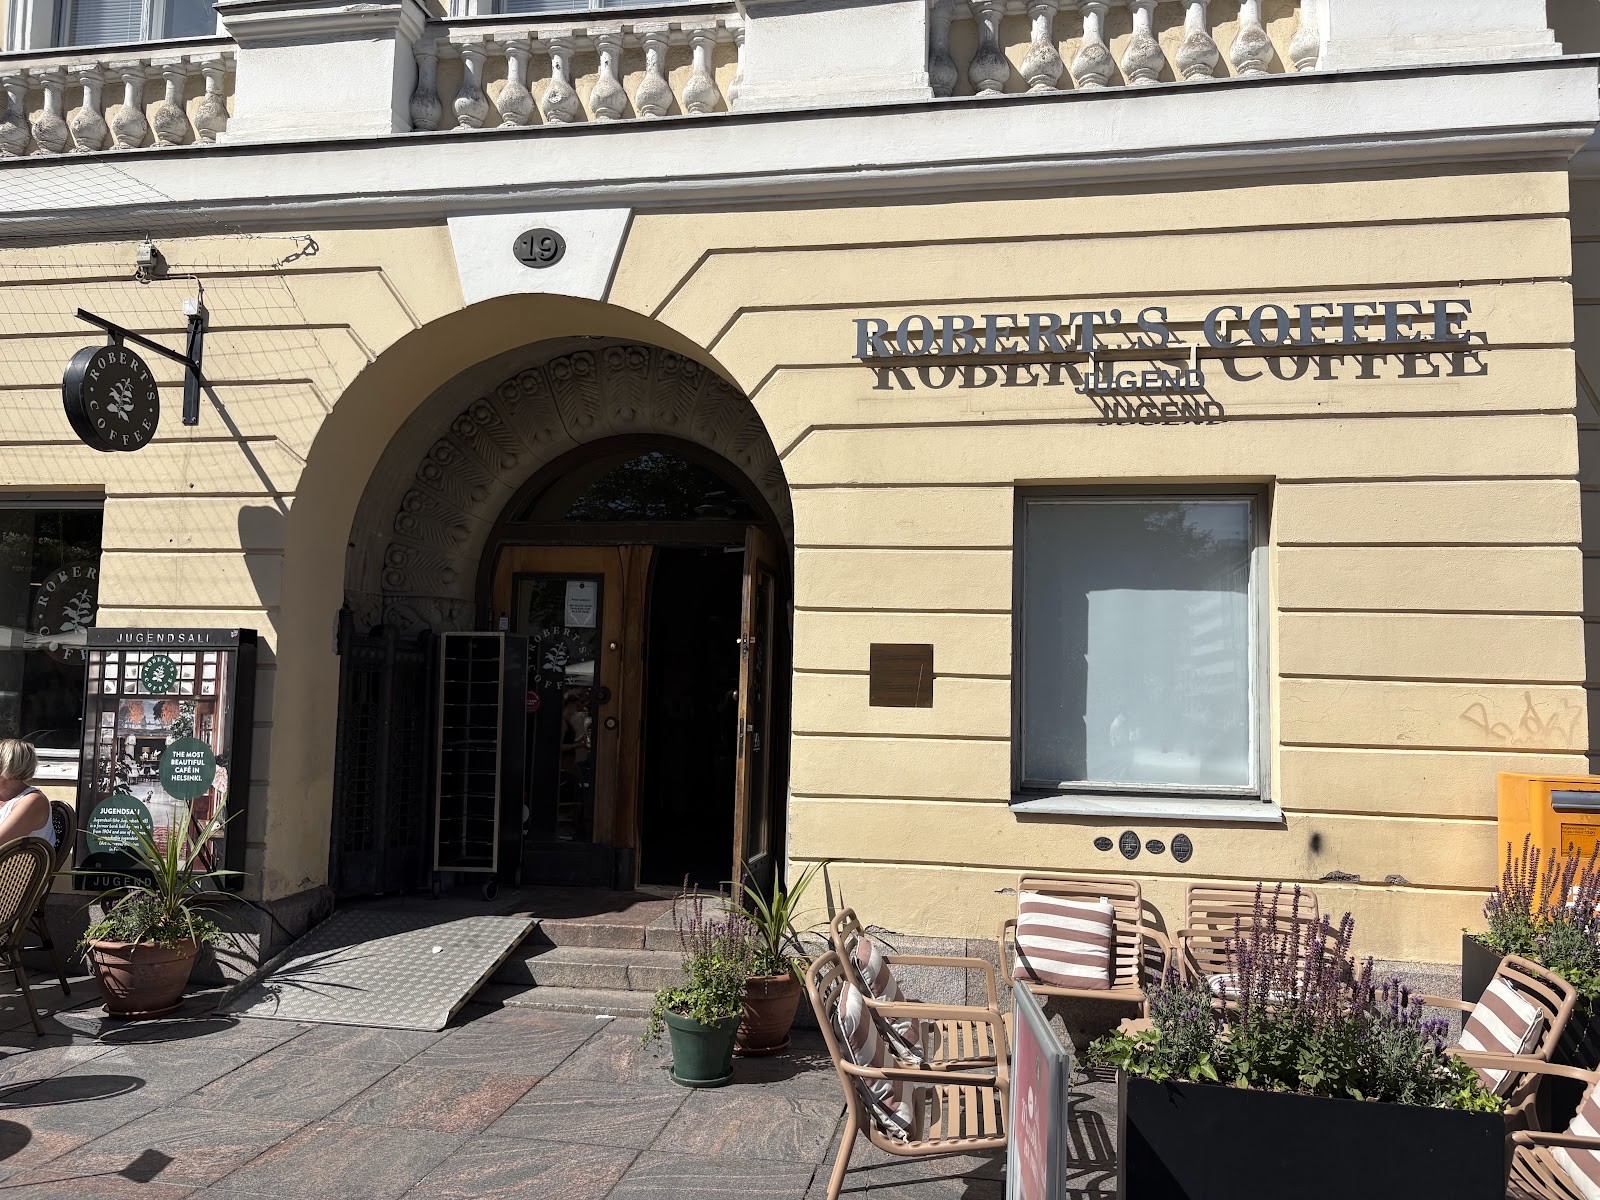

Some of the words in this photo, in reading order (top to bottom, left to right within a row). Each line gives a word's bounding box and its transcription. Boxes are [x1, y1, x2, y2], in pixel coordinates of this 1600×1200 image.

[520, 235, 558, 262] 19
[852, 306, 1170, 359] ROBERT'S
[1203, 299, 1472, 349] COFFEE
[90, 352, 155, 401] ROBERT'S
[1075, 369, 1205, 395] JUGEND
[90, 400, 152, 445] COFFEE
[116, 633, 210, 643] JUGENDSALI
[529, 626, 587, 653] ROBERT'S
[145, 656, 174, 672] ROBERT'S
[528, 664, 575, 690] COFFE
[144, 677, 173, 691] COFFEE
[174, 766, 191, 774] CAFÉ
